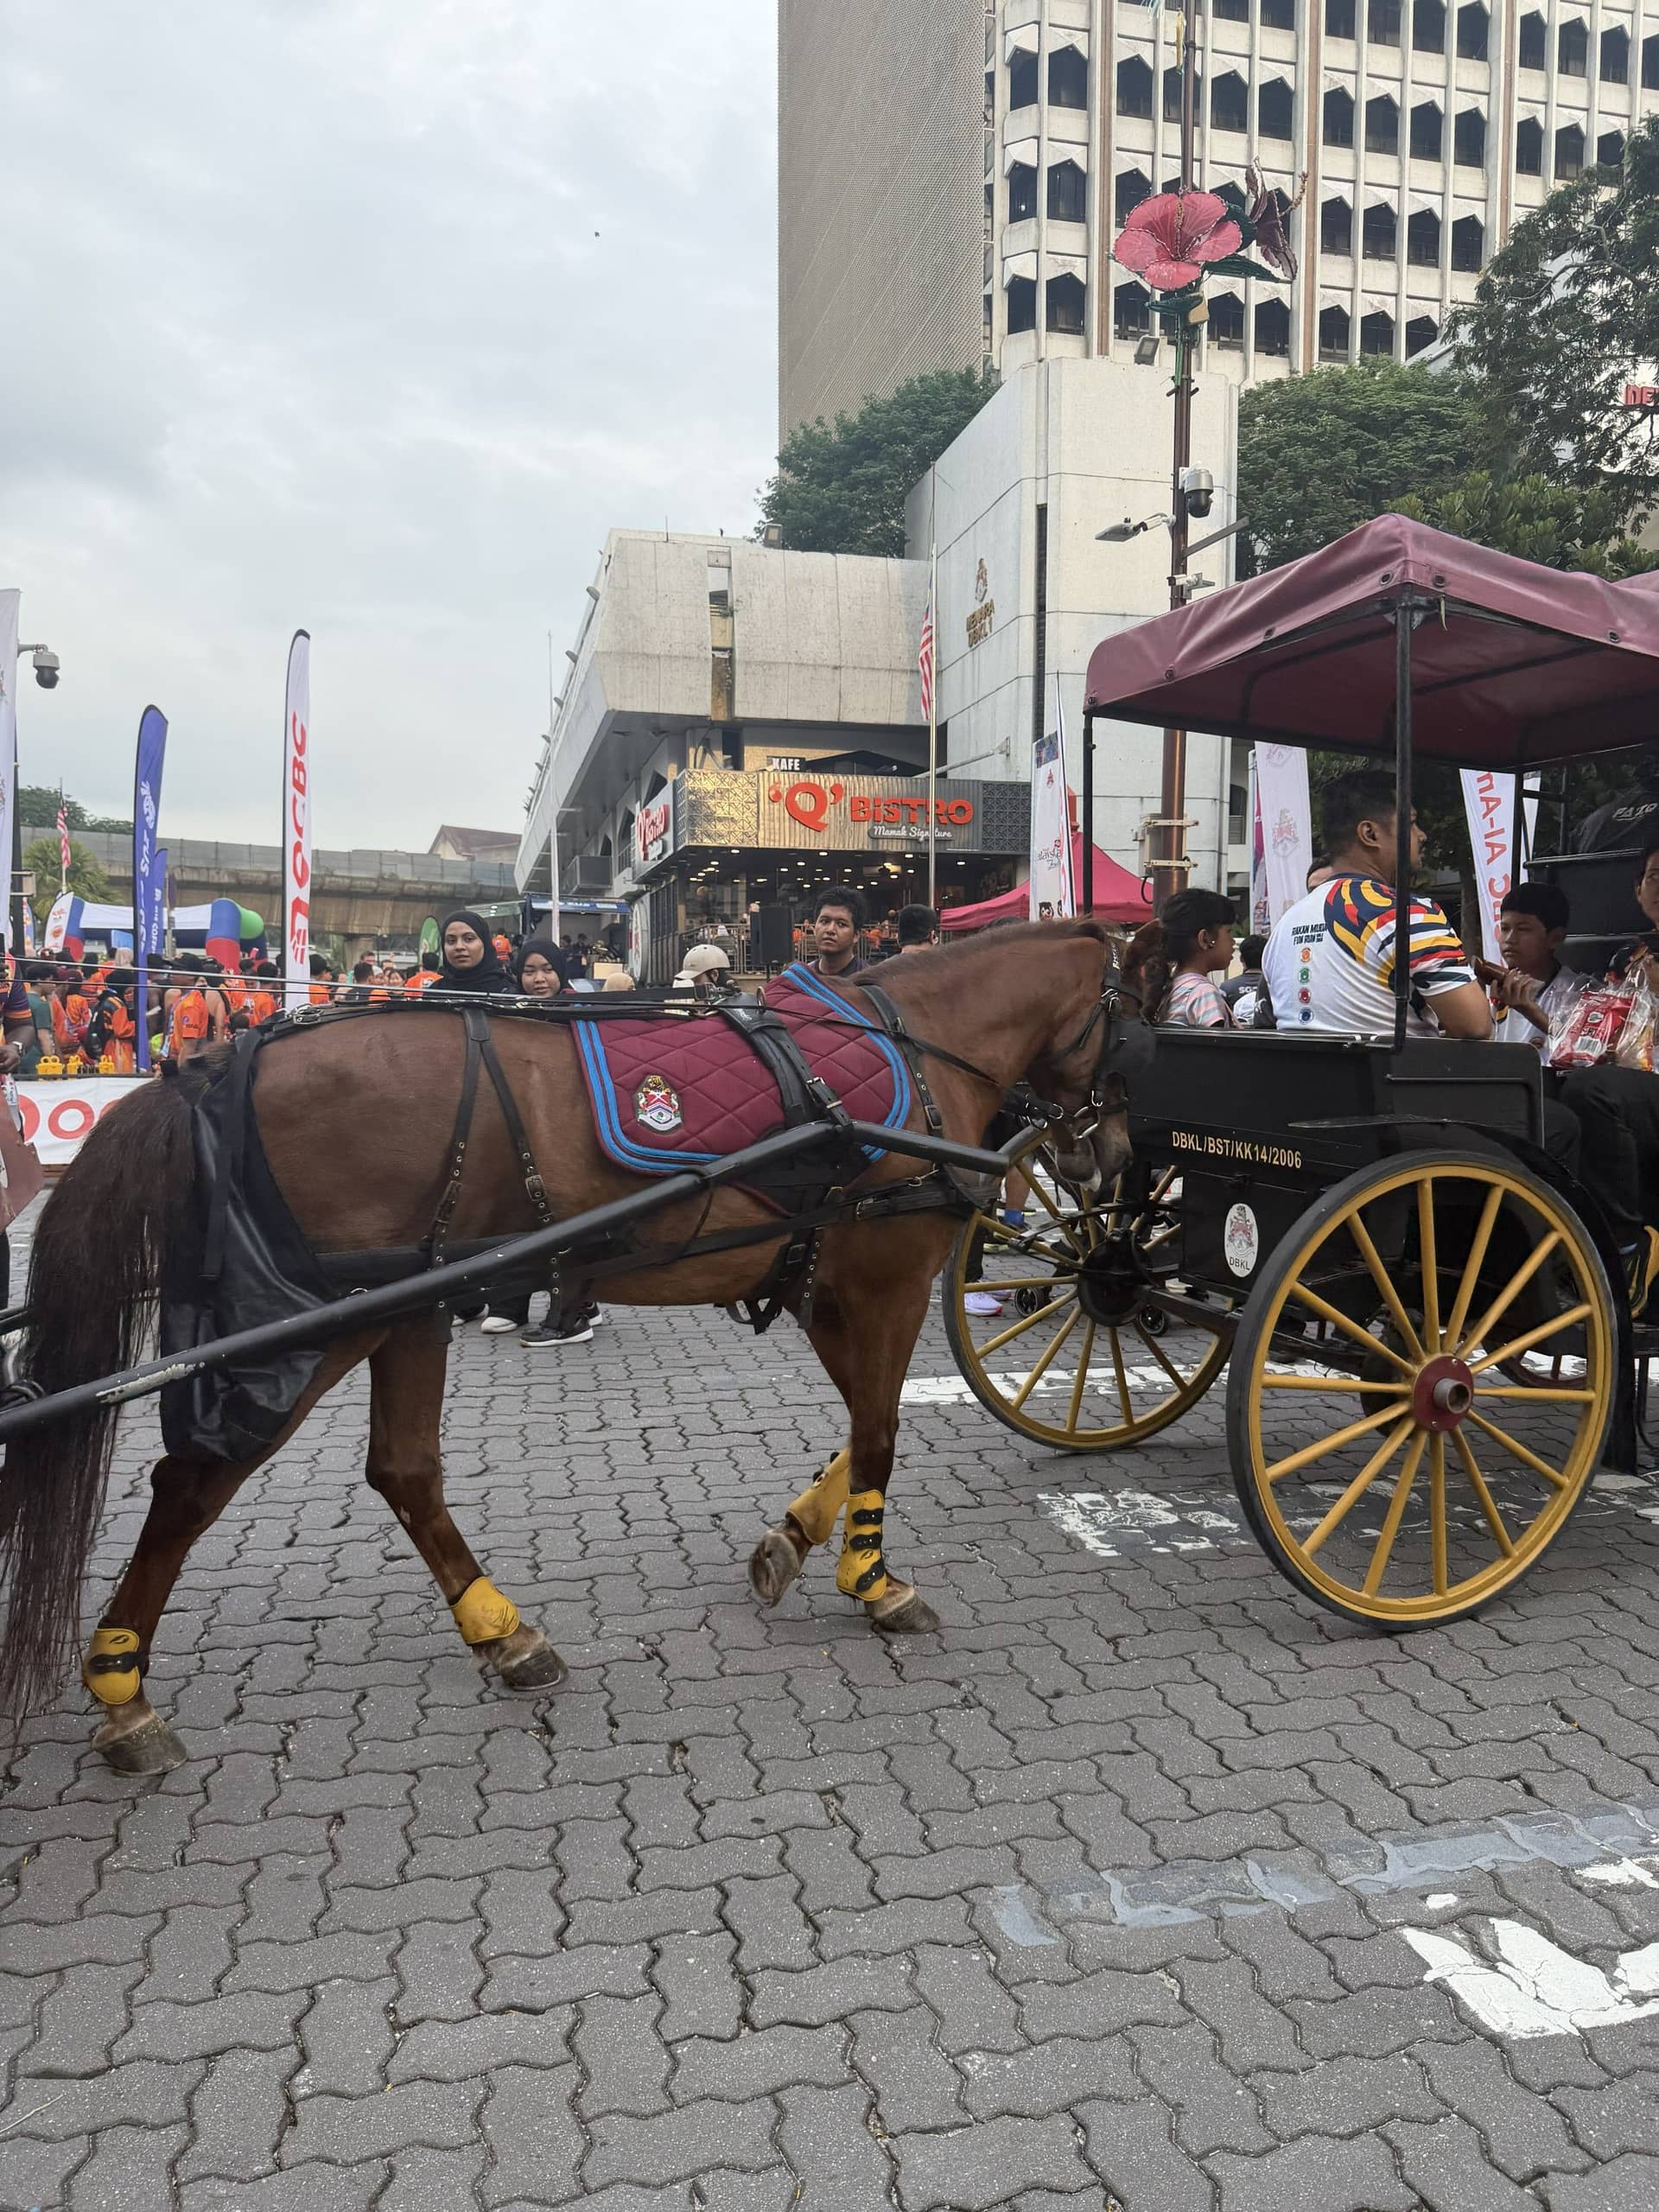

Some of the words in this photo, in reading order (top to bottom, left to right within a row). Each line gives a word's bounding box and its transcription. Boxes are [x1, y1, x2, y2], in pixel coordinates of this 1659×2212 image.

[772, 758, 800, 771] KAFE
[291, 711, 310, 890] OCBC
[874, 825, 907, 837] Mamak
[909, 826, 952, 842] Signture
[1229, 1257, 1250, 1271] DBKL
